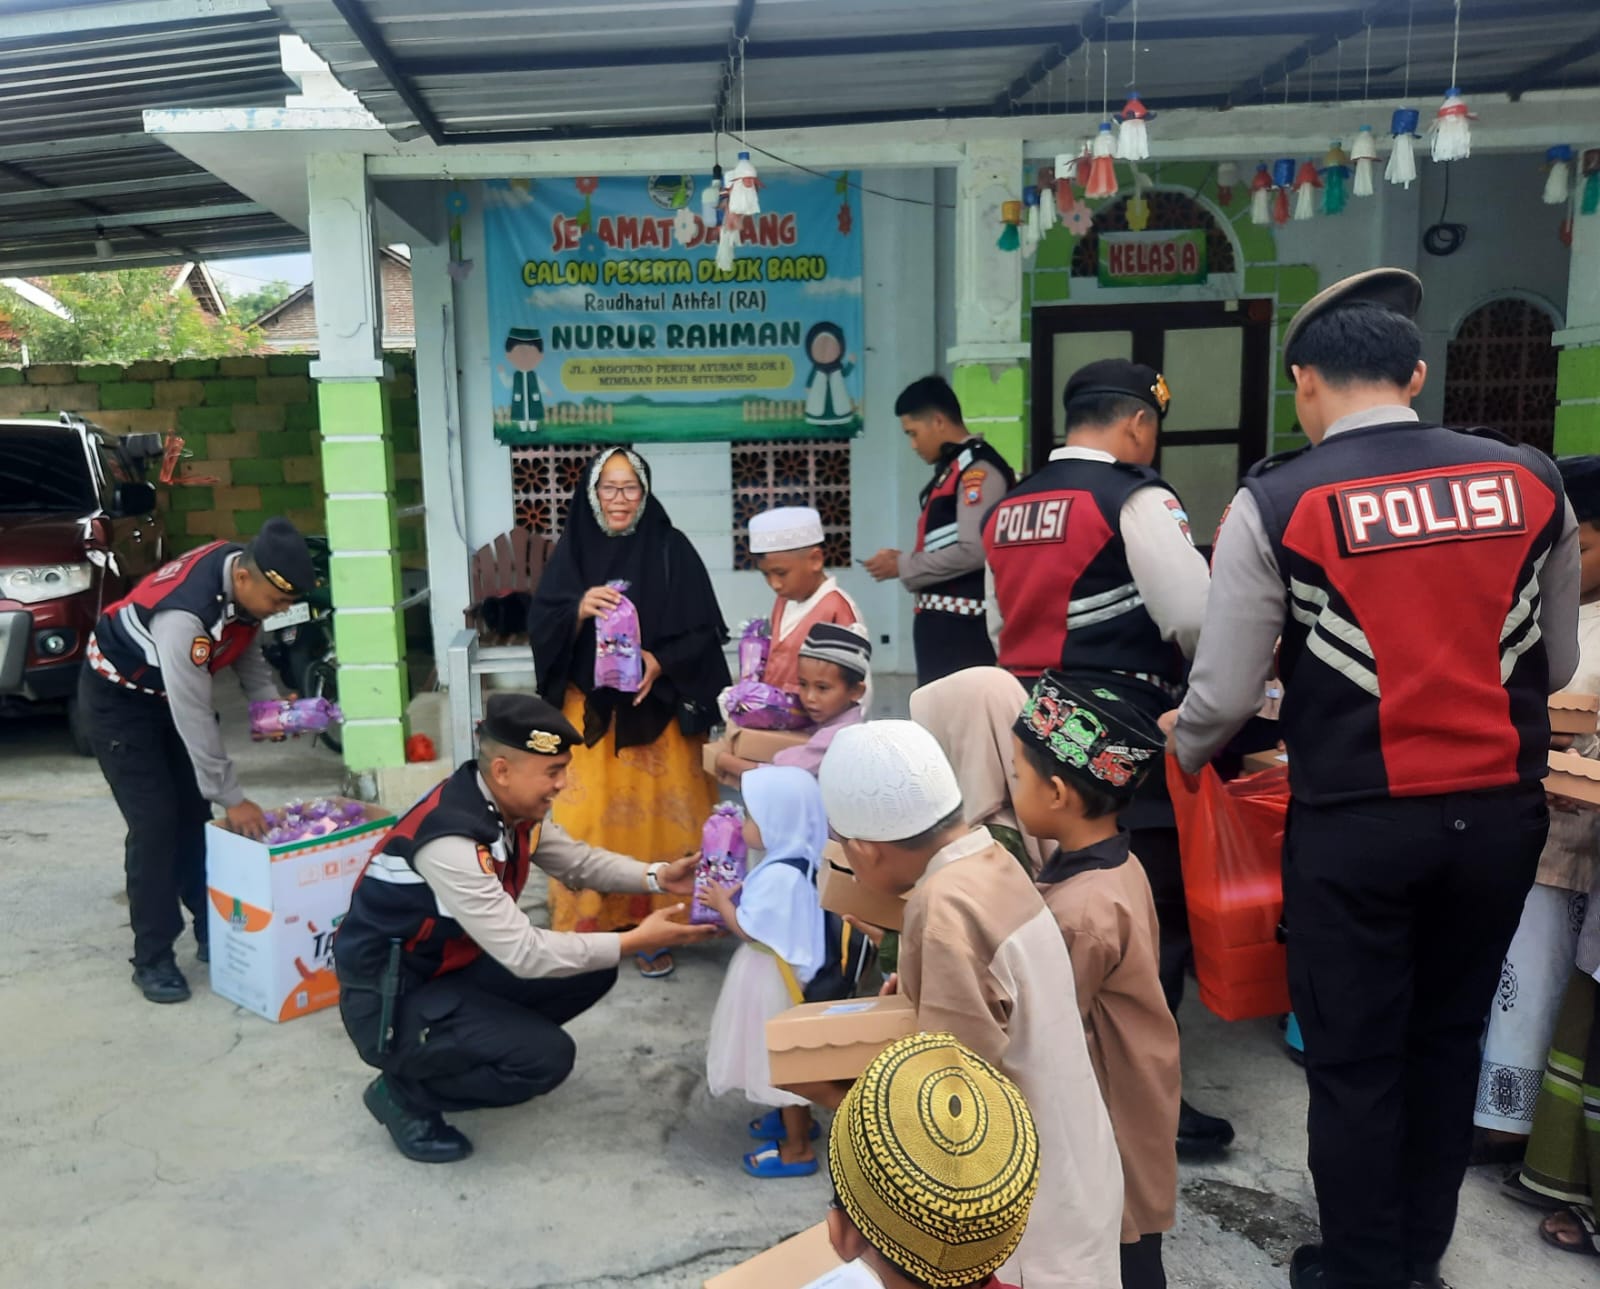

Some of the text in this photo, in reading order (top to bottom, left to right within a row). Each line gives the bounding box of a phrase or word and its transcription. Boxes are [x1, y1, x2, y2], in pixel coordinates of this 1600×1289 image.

[552, 212, 675, 252] SEAMAT
[522, 255, 827, 286] CALON PESERTA DIDIK BARU
[1108, 242, 1197, 274] KELAS A
[585, 290, 767, 313] Raudhatul Athfal (RA)
[552, 321, 801, 350] NURUR RAHMAN
[591, 364, 653, 375] ARGOPURO
[656, 362, 696, 374] PERUM
[747, 361, 777, 372] BLOK
[656, 375, 688, 385] PANJI
[691, 374, 757, 385] SITUBONDO
[994, 499, 1068, 544] POLISI
[1346, 475, 1522, 544] POLISI
